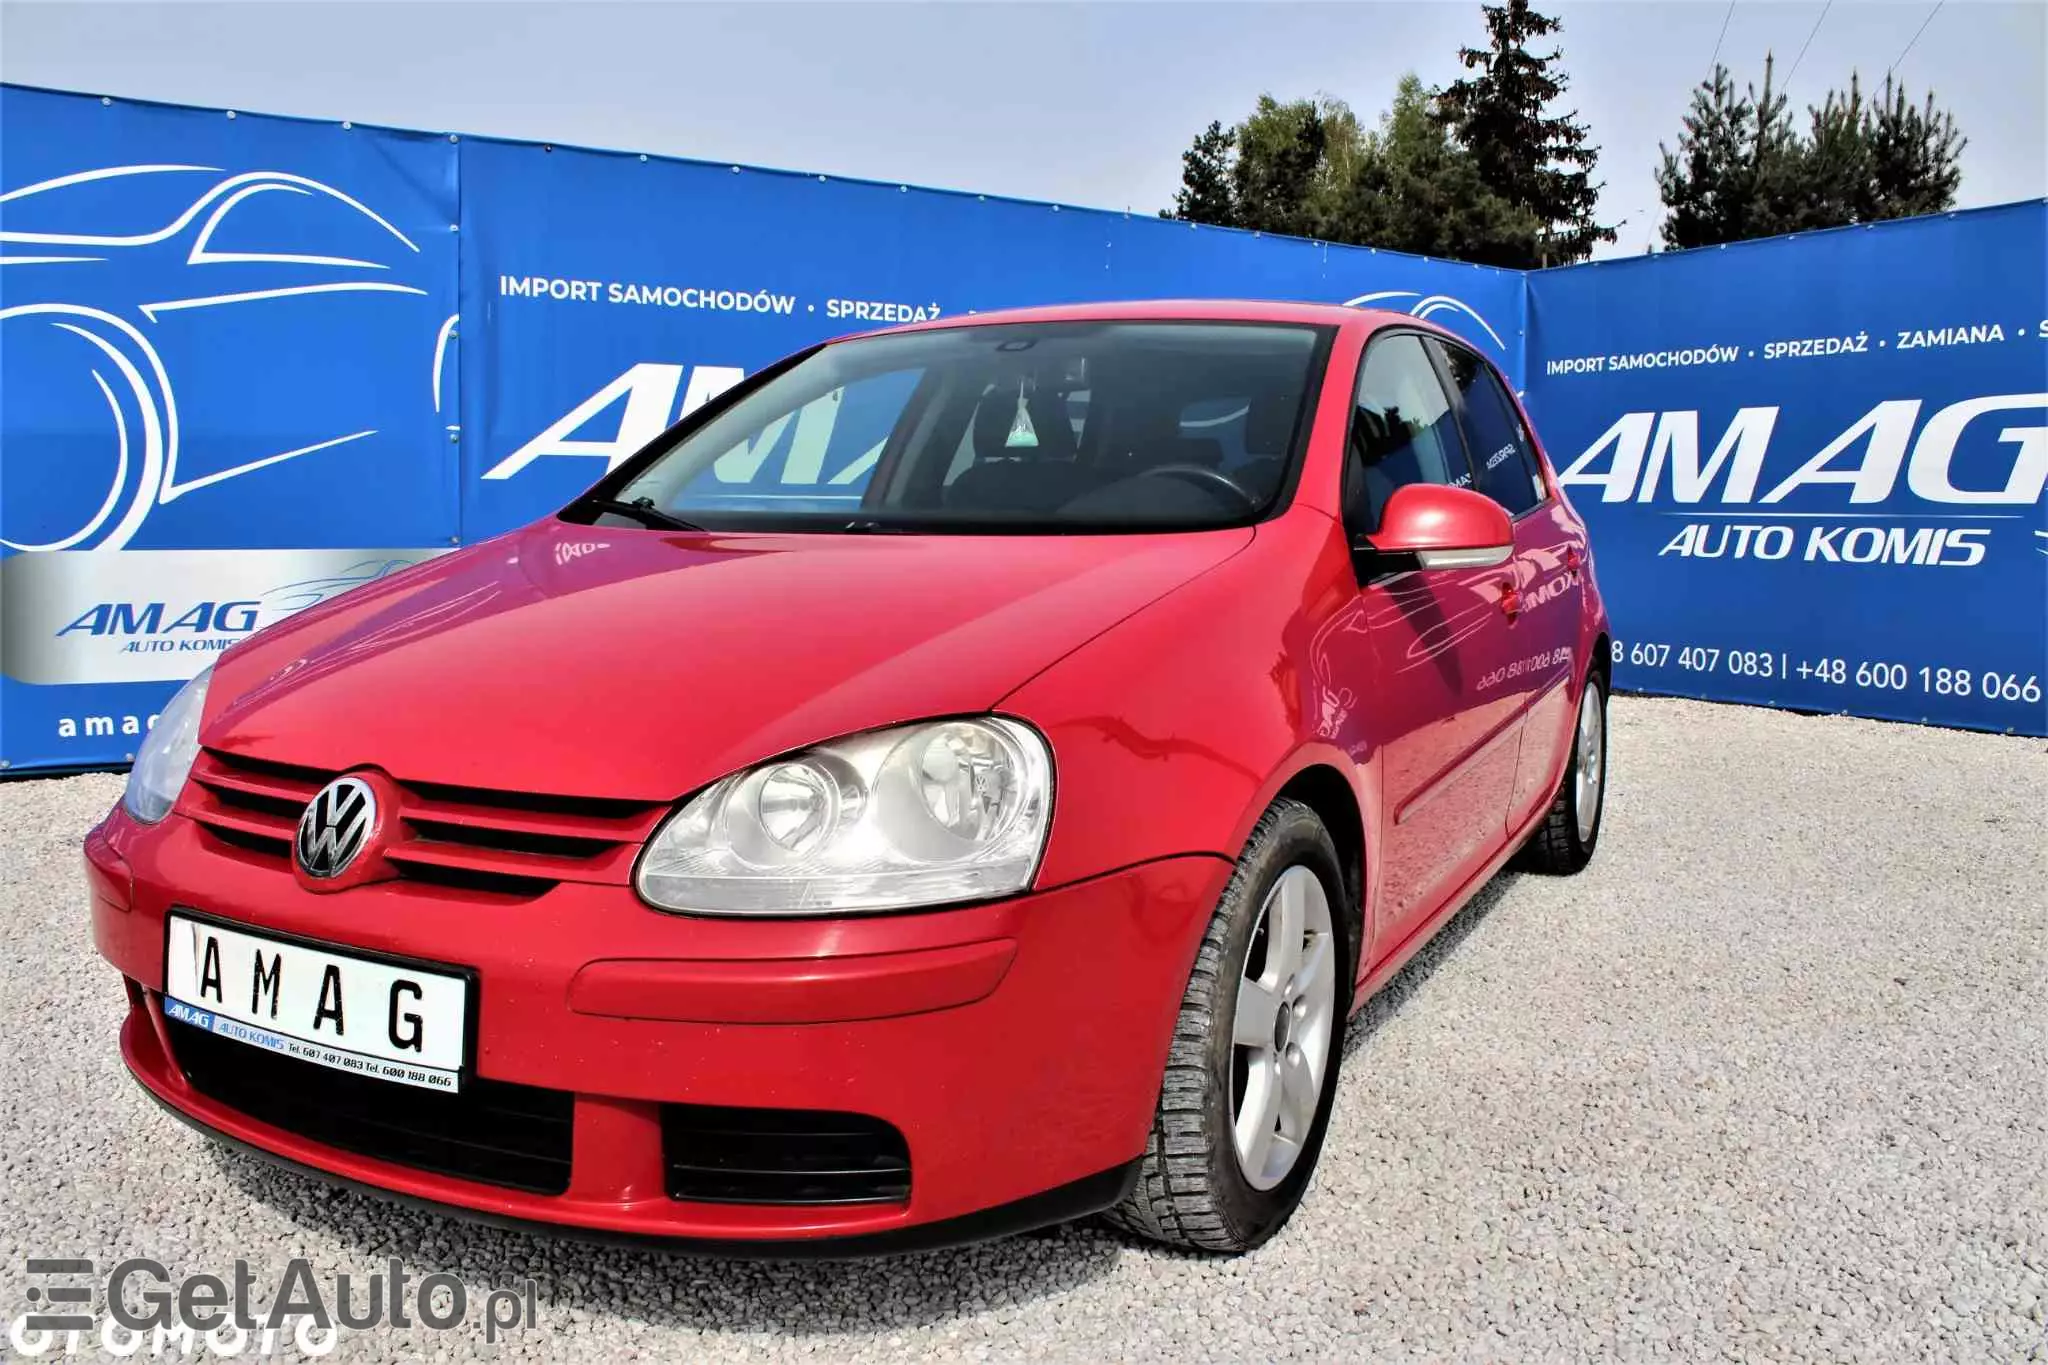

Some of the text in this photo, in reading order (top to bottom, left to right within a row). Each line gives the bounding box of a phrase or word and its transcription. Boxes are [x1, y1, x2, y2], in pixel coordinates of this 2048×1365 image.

[500, 275, 941, 323] IMPORT SAMOCHODÓW SPRZEDAŻ
[1546, 323, 2005, 376] IMPORT SAMOCHODÓW SPRZEDAŻ ZAMIANA
[1557, 392, 2048, 505] AMAG
[1658, 524, 1992, 567] AUTO KOMIS
[55, 601, 262, 637] AMAG
[119, 639, 175, 654] AUTO
[1630, 641, 1671, 668] 607
[1677, 645, 1720, 673] 407
[1728, 649, 1773, 679] 083
[1796, 656, 1847, 686] +48
[1855, 660, 1907, 692] 600
[1918, 665, 1972, 697] 188
[1982, 670, 2042, 703] 066
[168, 1003, 210, 1028] AMAG
[219, 1022, 248, 1040] AUTO
[249, 1030, 285, 1051] KOMIS
[302, 1046, 321, 1060] 607
[323, 1053, 342, 1065] 407
[343, 1056, 364, 1071] 083
[382, 1065, 405, 1080] 600
[408, 1070, 426, 1083] 188
[428, 1074, 452, 1088] 066
